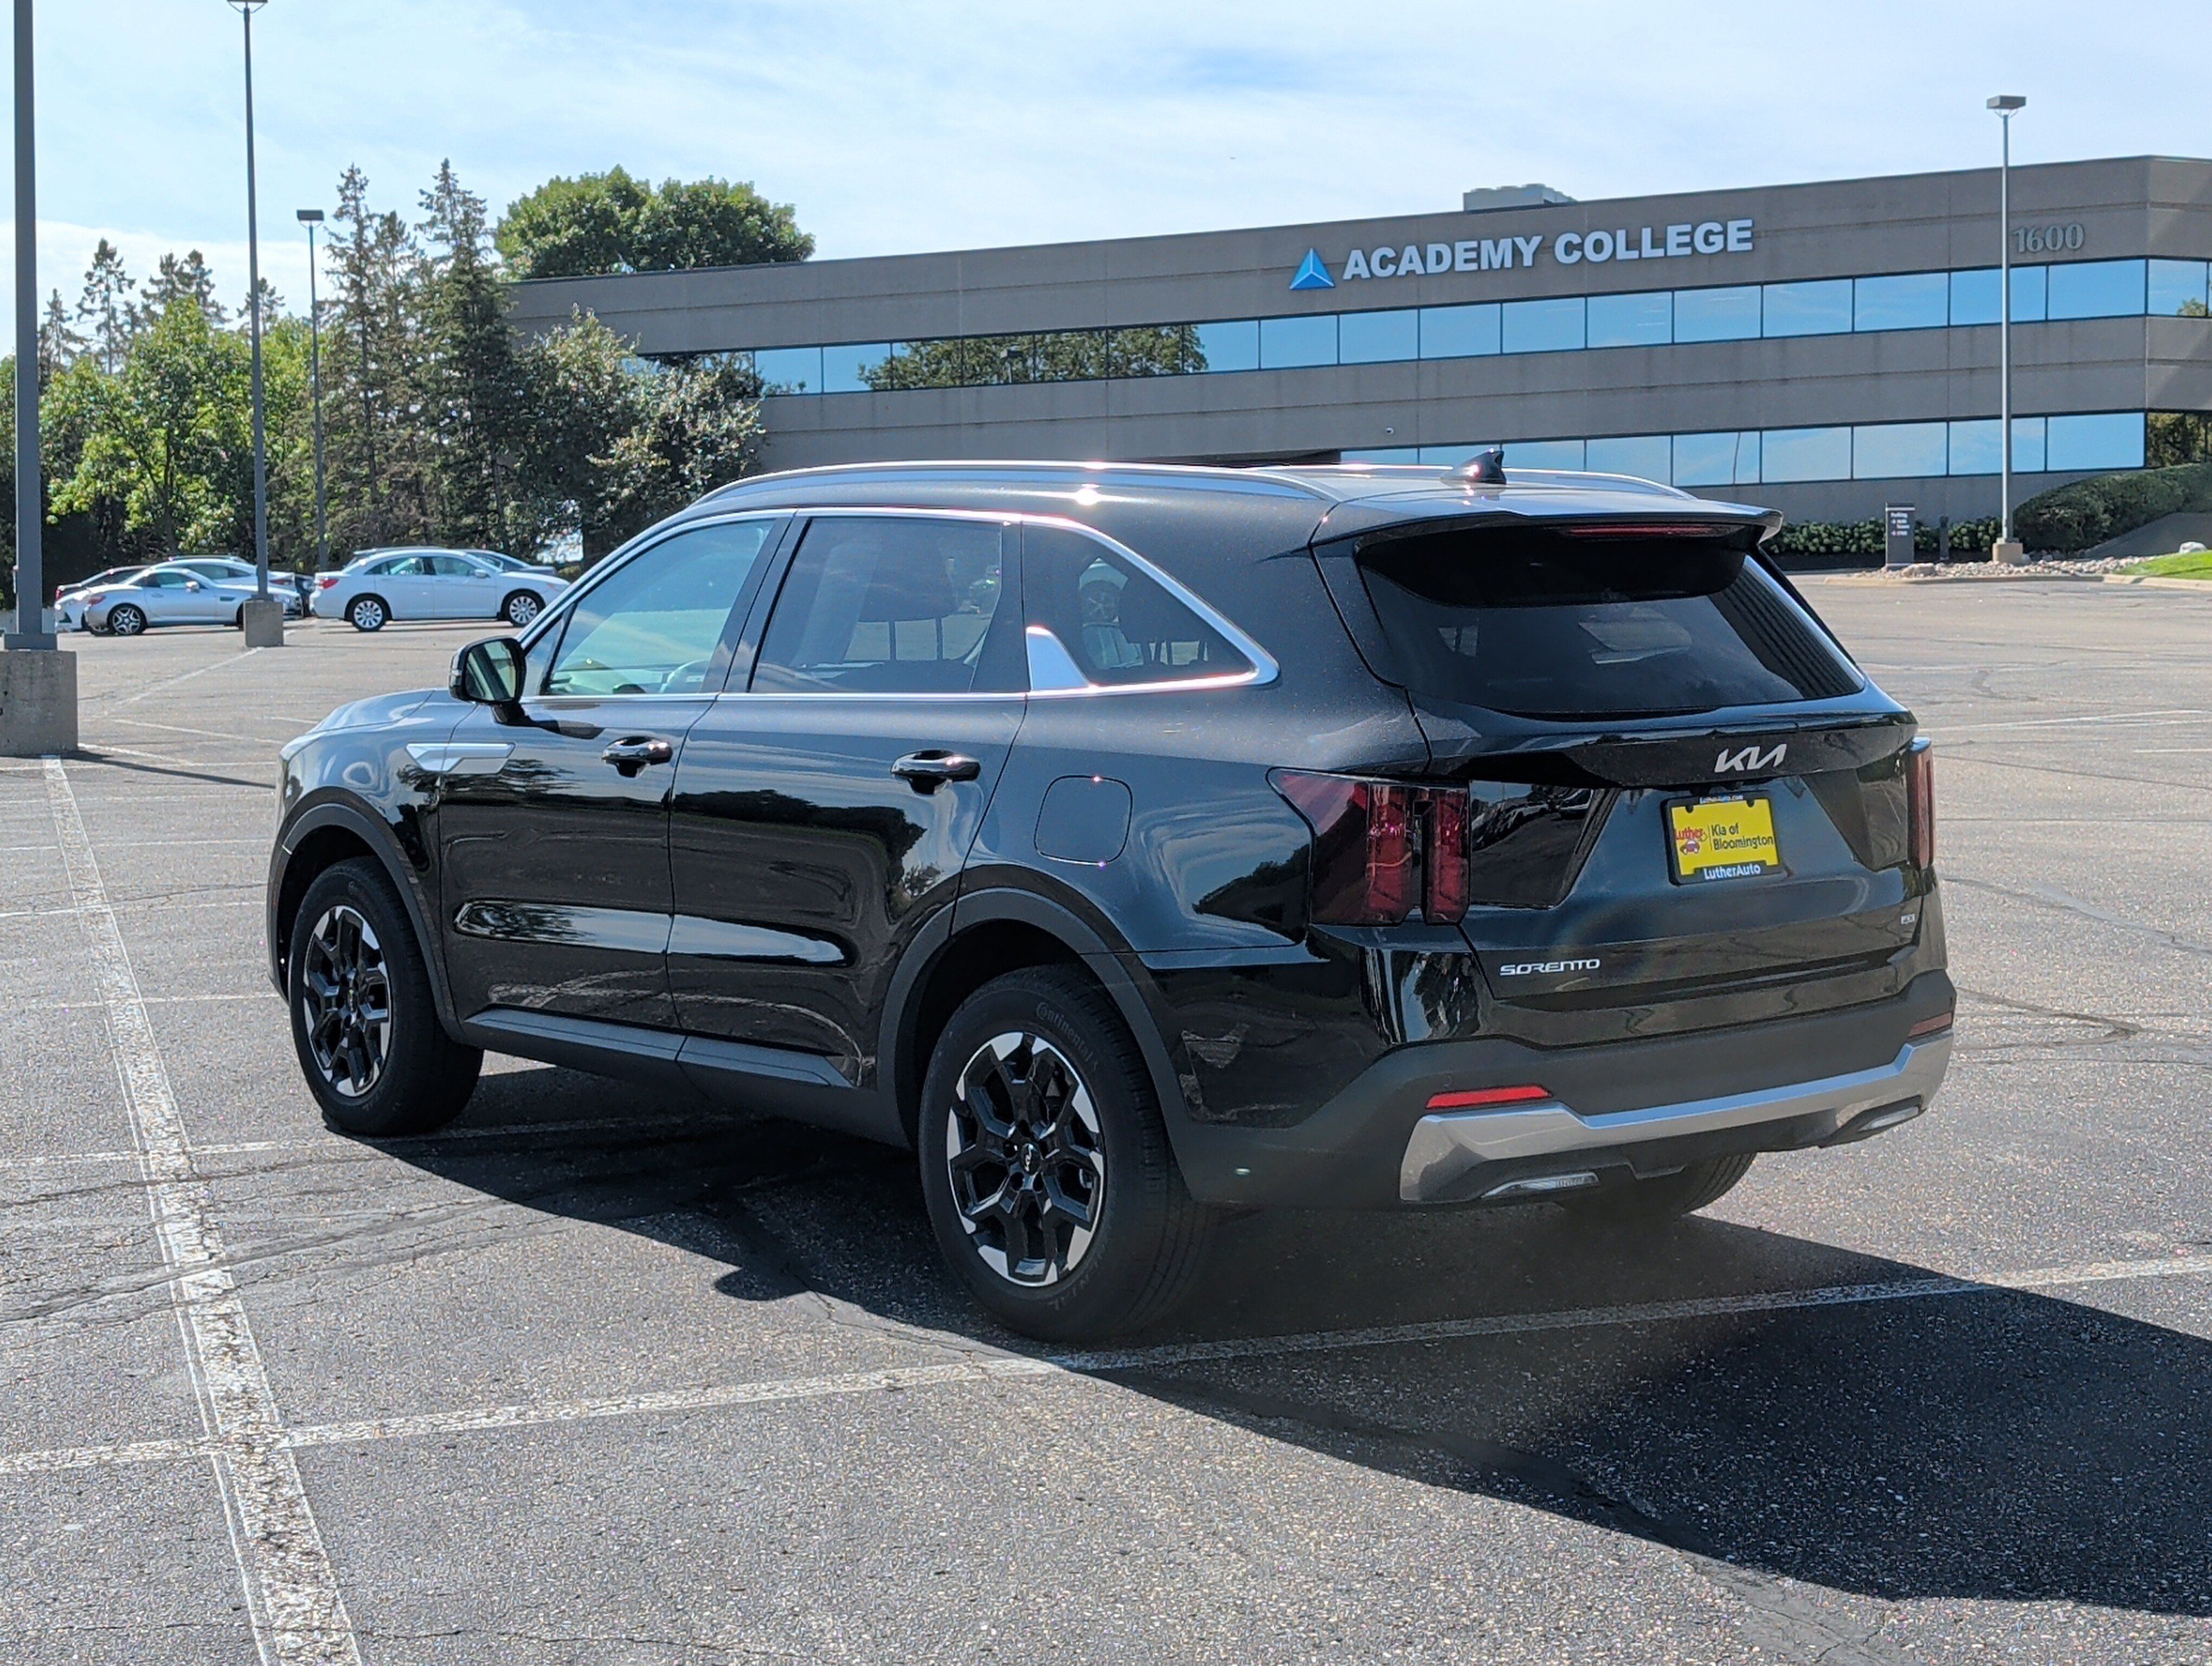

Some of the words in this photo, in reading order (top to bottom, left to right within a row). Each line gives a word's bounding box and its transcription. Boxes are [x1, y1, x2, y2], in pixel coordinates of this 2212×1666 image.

[2014, 223, 2084, 253] 1600
[1342, 235, 1543, 280] ACADEMY
[1554, 218, 1754, 264] COLLEGE
[1714, 744, 1787, 773] KIA
[1675, 825, 1703, 840] Luther
[1711, 824, 1727, 836] Kia
[1728, 823, 1739, 835] of
[1713, 835, 1773, 850] Bloomington
[1703, 863, 1761, 880] LutherAuto
[1500, 958, 1600, 976] SORENTO
